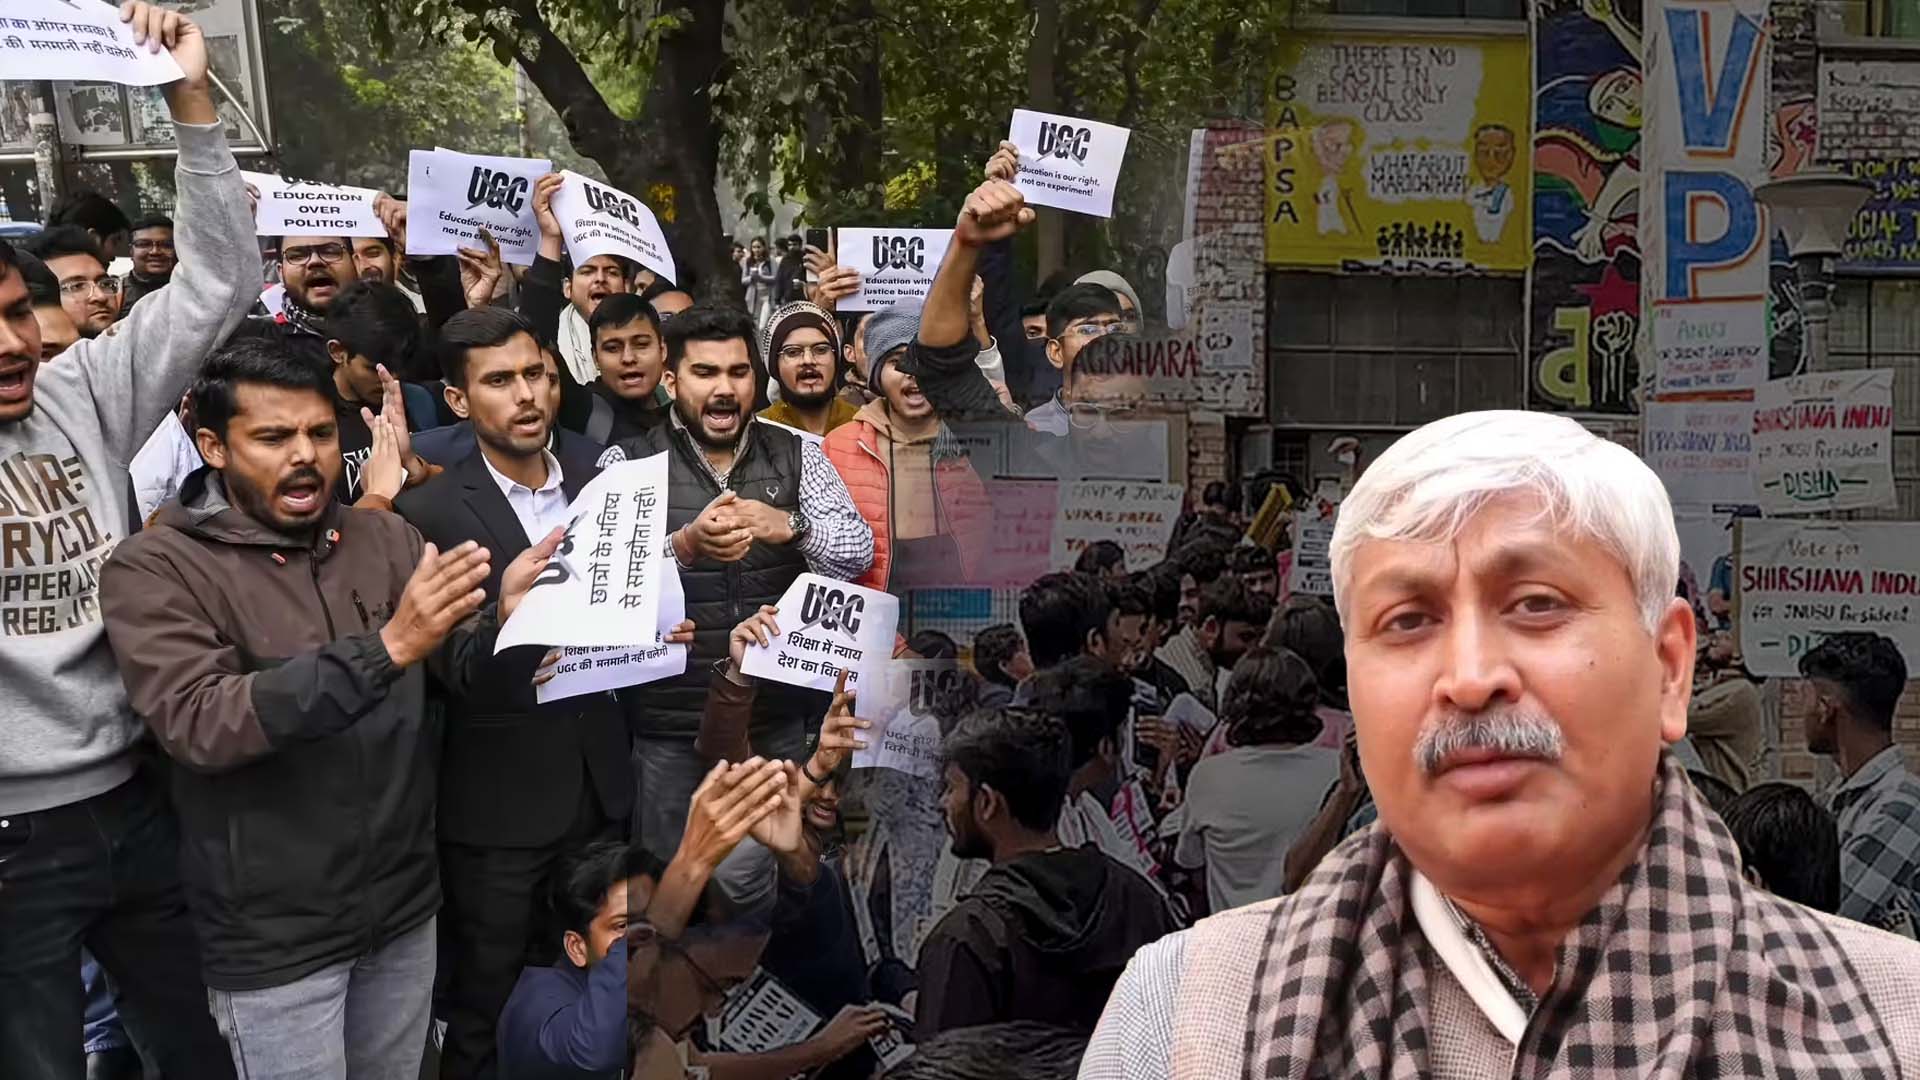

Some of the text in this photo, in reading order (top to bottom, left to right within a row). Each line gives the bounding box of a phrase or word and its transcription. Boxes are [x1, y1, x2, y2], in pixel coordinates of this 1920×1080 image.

[9, 18, 30, 30] का
[32, 17, 69, 32] आंगन
[69, 24, 108, 38] सबका
[108, 26, 118, 41] है
[29, 39, 80, 51] मनमानी
[80, 40, 104, 54] नहीं
[104, 44, 138, 60] चलेगी
[1331, 45, 1456, 66] THERE IS NO
[1331, 65, 1429, 84] CASTE IN
[1363, 101, 1424, 122] CLASS
[1037, 121, 1091, 161] UGC
[1017, 164, 1053, 178] Education
[1054, 171, 1061, 179] is
[1062, 174, 1076, 182] our
[273, 191, 362, 201] EDUCATION
[467, 166, 528, 212] UGC
[1021, 177, 1034, 185] not
[1047, 182, 1094, 197] experiment!
[298, 205, 341, 214] OVER
[583, 183, 639, 227] UGC
[284, 219, 357, 228] POLITICS!
[439, 210, 533, 239] Education is our right,
[442, 226, 525, 247] not an exriment!
[873, 236, 925, 269] UGC
[864, 287, 925, 296] justice builds
[865, 277, 911, 285] Education
[1783, 470, 1839, 495] DISHA
[588, 491, 621, 606] छात्रों के भविष्य
[624, 523, 651, 589] समझौता
[1788, 538, 1827, 557] Vote
[0, 569, 72, 602] PPER
[618, 593, 642, 610] से
[800, 582, 865, 635] UGC
[3, 605, 61, 636] REG.
[787, 631, 863, 662] शिक्षा में न्याय
[557, 663, 577, 674] UGC
[579, 658, 592, 670] की
[596, 653, 630, 668] मनमानी
[630, 650, 646, 663] नहीं
[646, 645, 668, 660] चलेगी
[777, 650, 799, 669] देश
[800, 659, 819, 674] का
